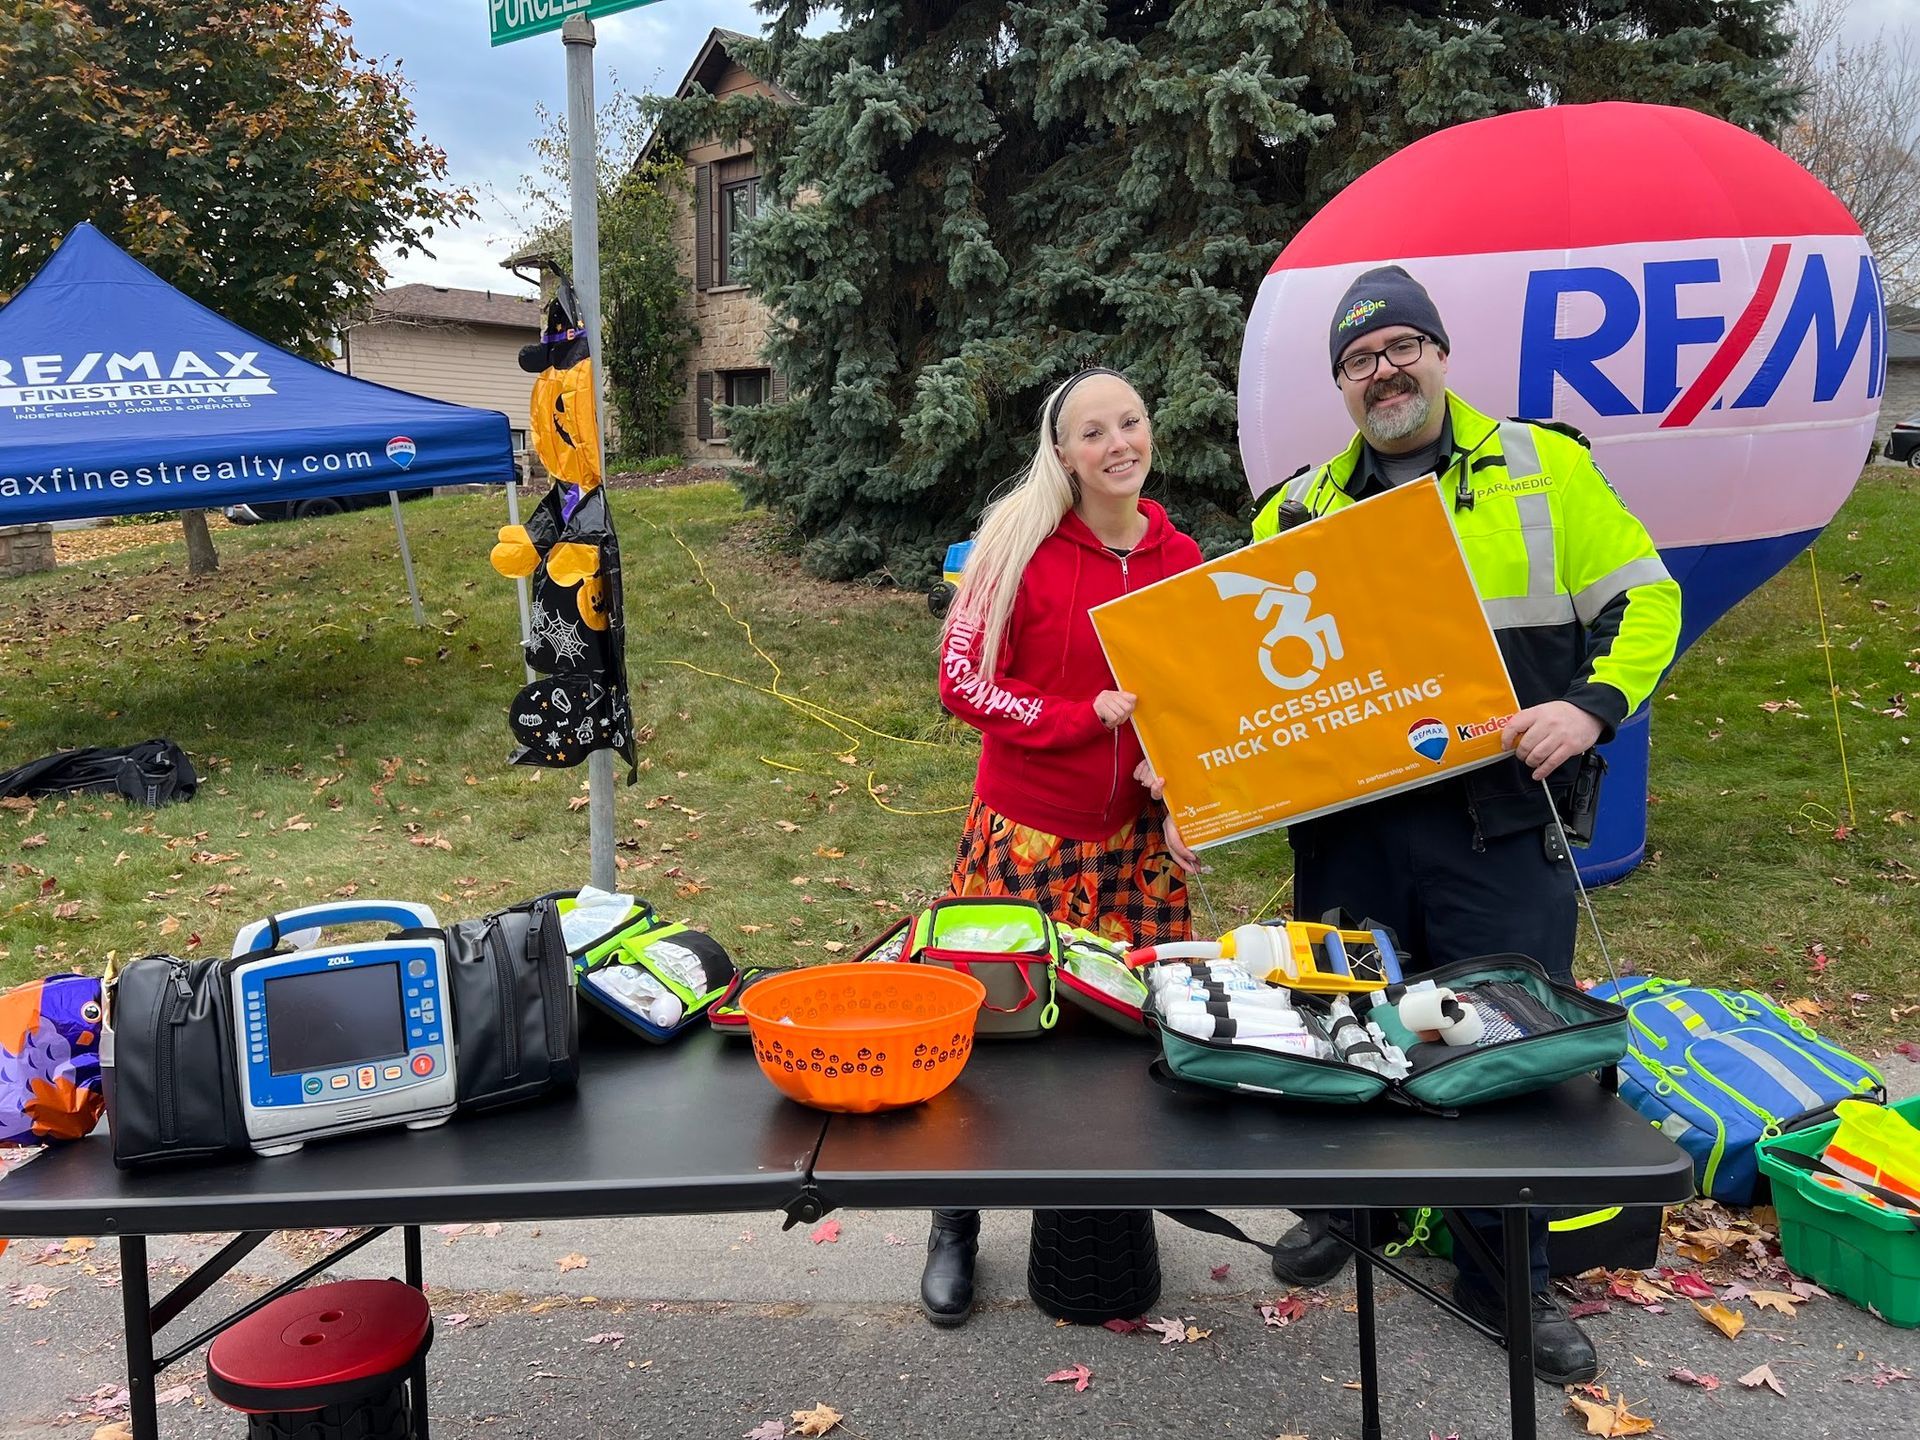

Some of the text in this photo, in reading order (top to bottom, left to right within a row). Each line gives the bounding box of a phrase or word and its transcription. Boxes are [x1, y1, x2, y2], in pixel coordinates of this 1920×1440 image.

[1338, 300, 1386, 332] PARAMEDIC
[1518, 243, 1888, 429] RE/M
[20, 382, 231, 401] FINEST REALTY
[12, 404, 67, 413] INC.
[108, 396, 250, 408] BROKERAGE
[15, 409, 123, 420] INDEPENDENTLY
[125, 405, 173, 414] OWNED
[187, 402, 251, 411] OPERATED
[1477, 477, 1553, 498] PARAMEDIC
[1239, 669, 1387, 735] ACCESSIBLE
[1413, 728, 1443, 742] RE/MAX
[1198, 735, 1268, 770] TRICK
[1272, 722, 1309, 747] OR
[1365, 767, 1404, 784] partnership
[1405, 762, 1420, 771] with
[327, 956, 352, 966] ZOLL
